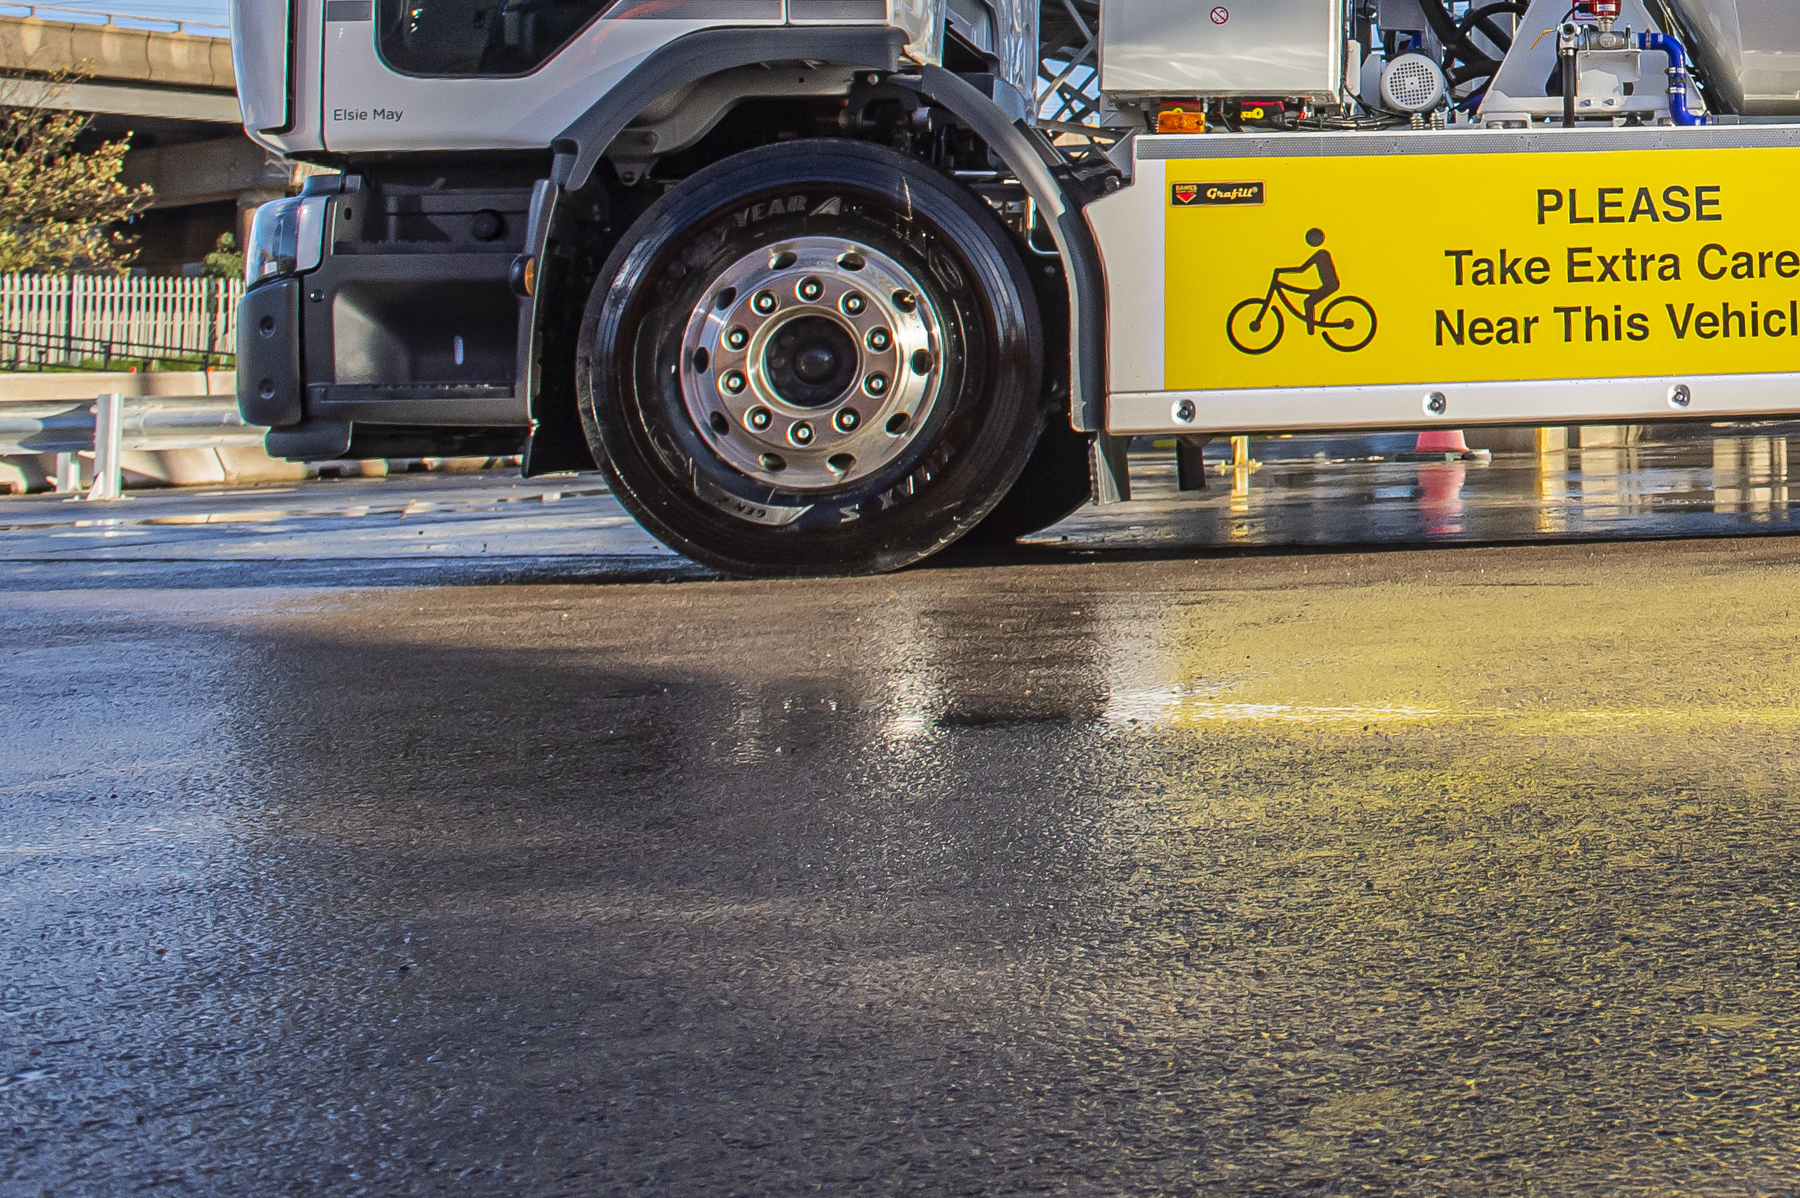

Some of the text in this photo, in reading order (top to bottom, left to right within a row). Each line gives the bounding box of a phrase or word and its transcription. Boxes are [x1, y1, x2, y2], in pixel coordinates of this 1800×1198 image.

[333, 108, 404, 122] Elsie May
[1536, 185, 1723, 226] PLEASE
[1444, 248, 1551, 287] Take
[1565, 245, 1682, 284] Extra
[1434, 308, 1540, 347] Near
[1553, 304, 1651, 343] This
